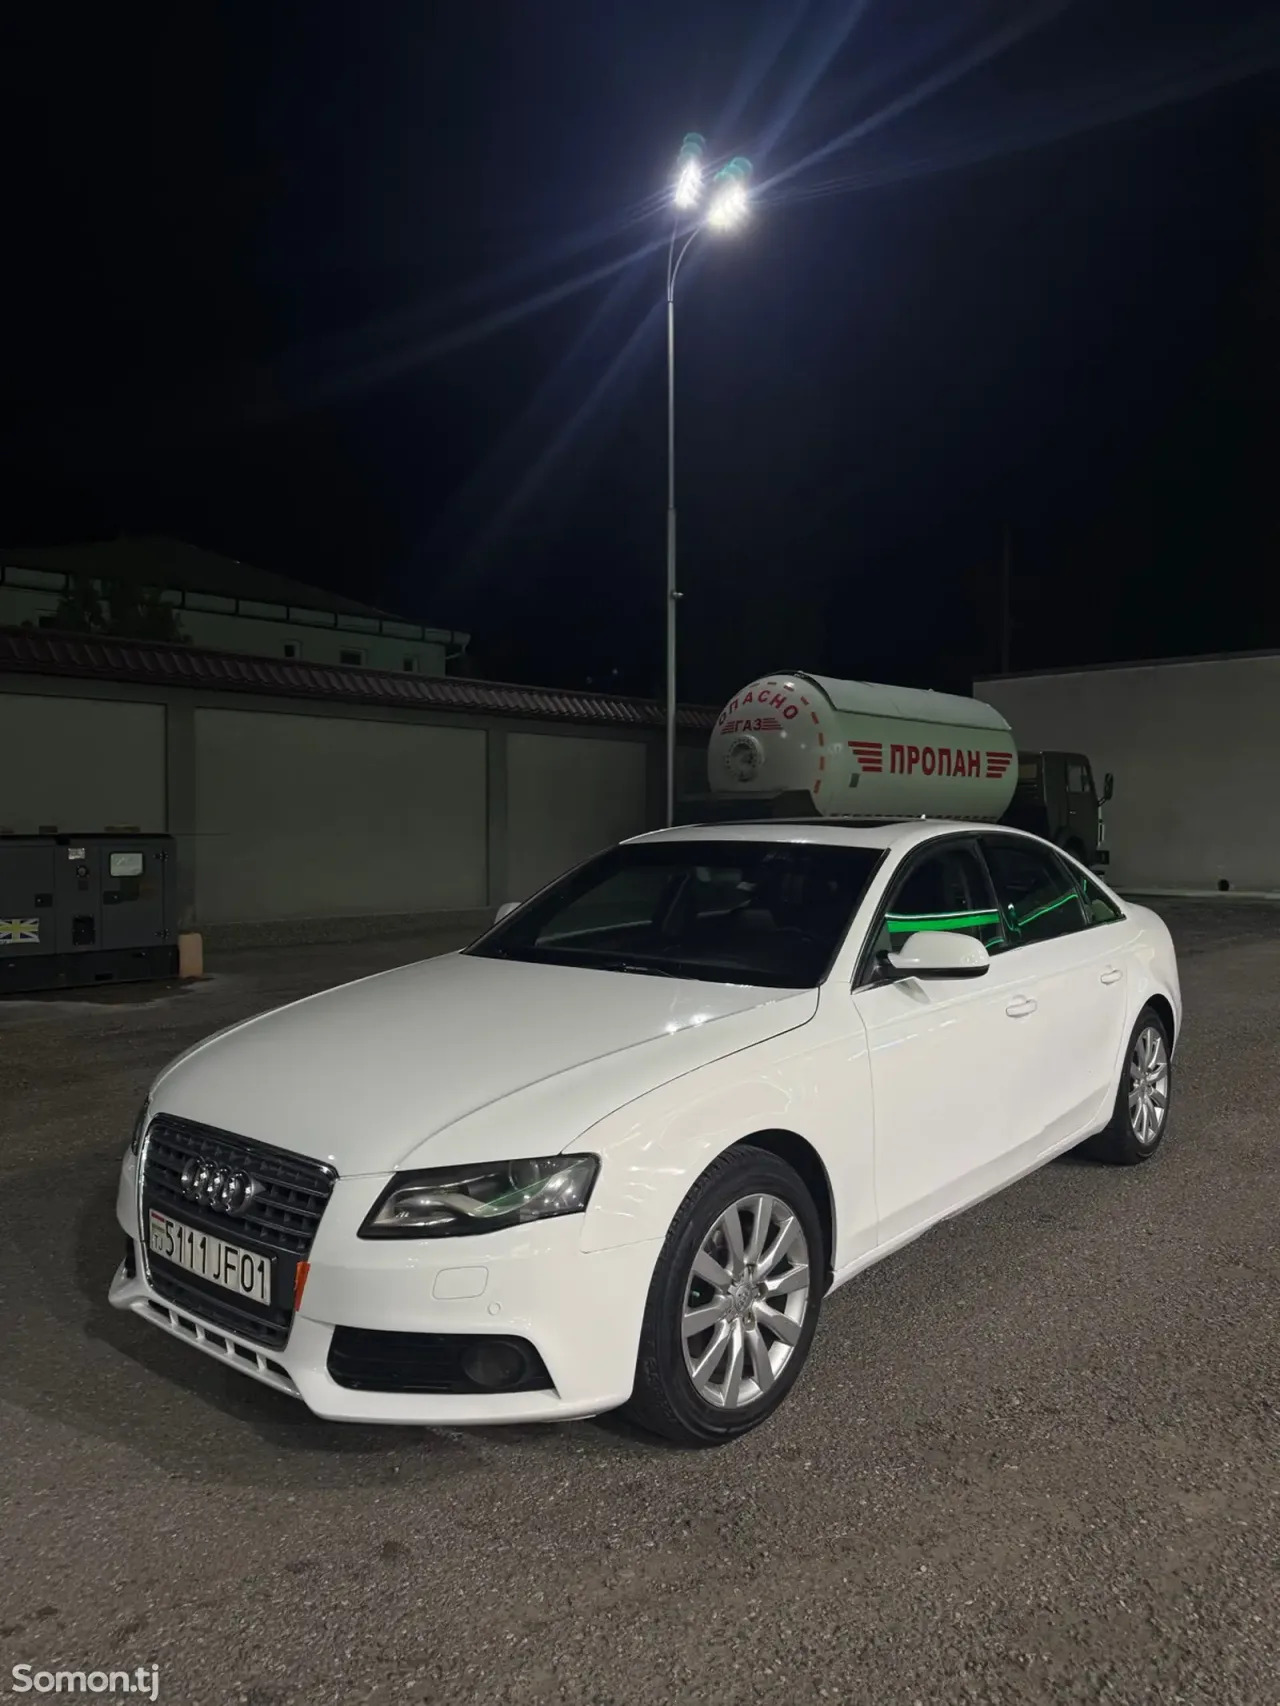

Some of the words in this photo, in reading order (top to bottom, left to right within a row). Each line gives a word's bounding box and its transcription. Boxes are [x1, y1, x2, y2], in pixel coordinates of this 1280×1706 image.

[718, 689, 799, 726] ОПАСНО
[734, 718, 762, 732] ГАЗ
[890, 744, 981, 777] ПРОПАН
